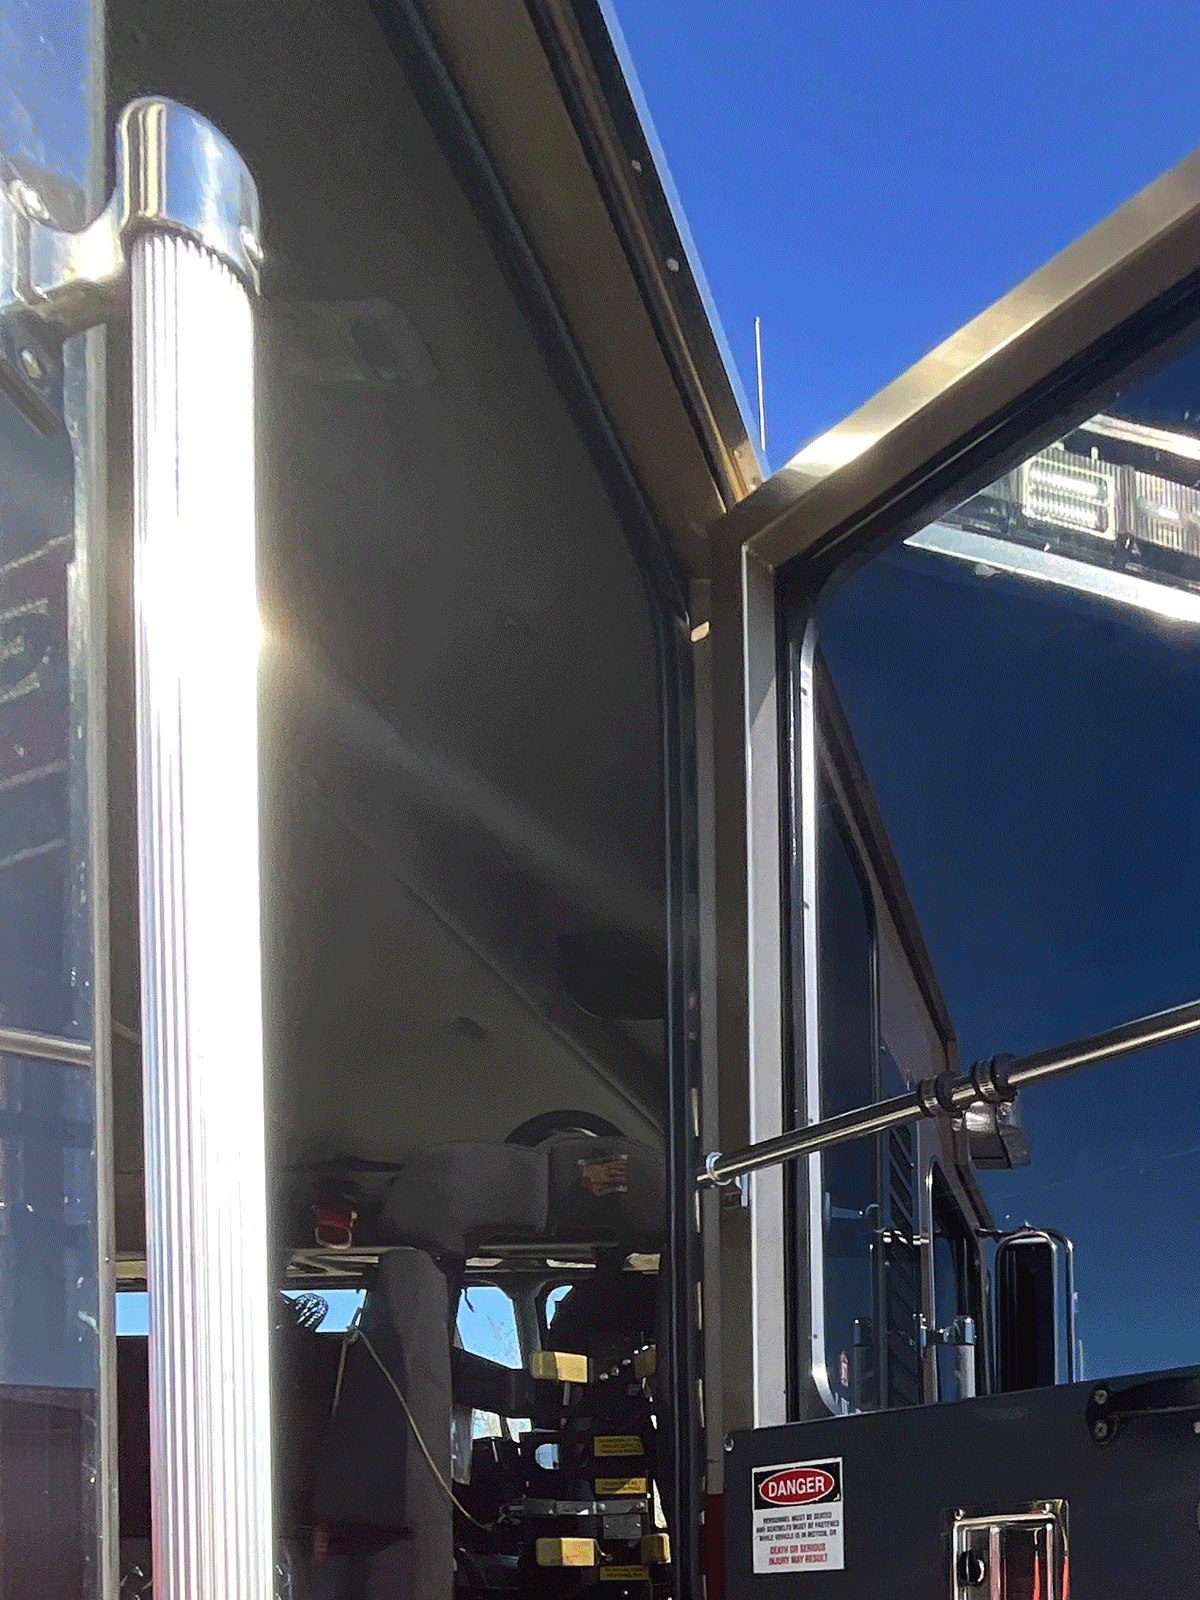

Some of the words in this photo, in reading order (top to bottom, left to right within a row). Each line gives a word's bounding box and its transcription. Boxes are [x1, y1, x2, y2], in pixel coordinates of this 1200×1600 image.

[768, 1476, 825, 1497] DANGER
[770, 1546, 788, 1554] DEATH
[790, 1545, 798, 1553] OR
[800, 1543, 826, 1553] SERIOUS
[769, 1556, 789, 1565] INJURY
[791, 1555, 804, 1564] MAY
[805, 1553, 828, 1563] RESULT
